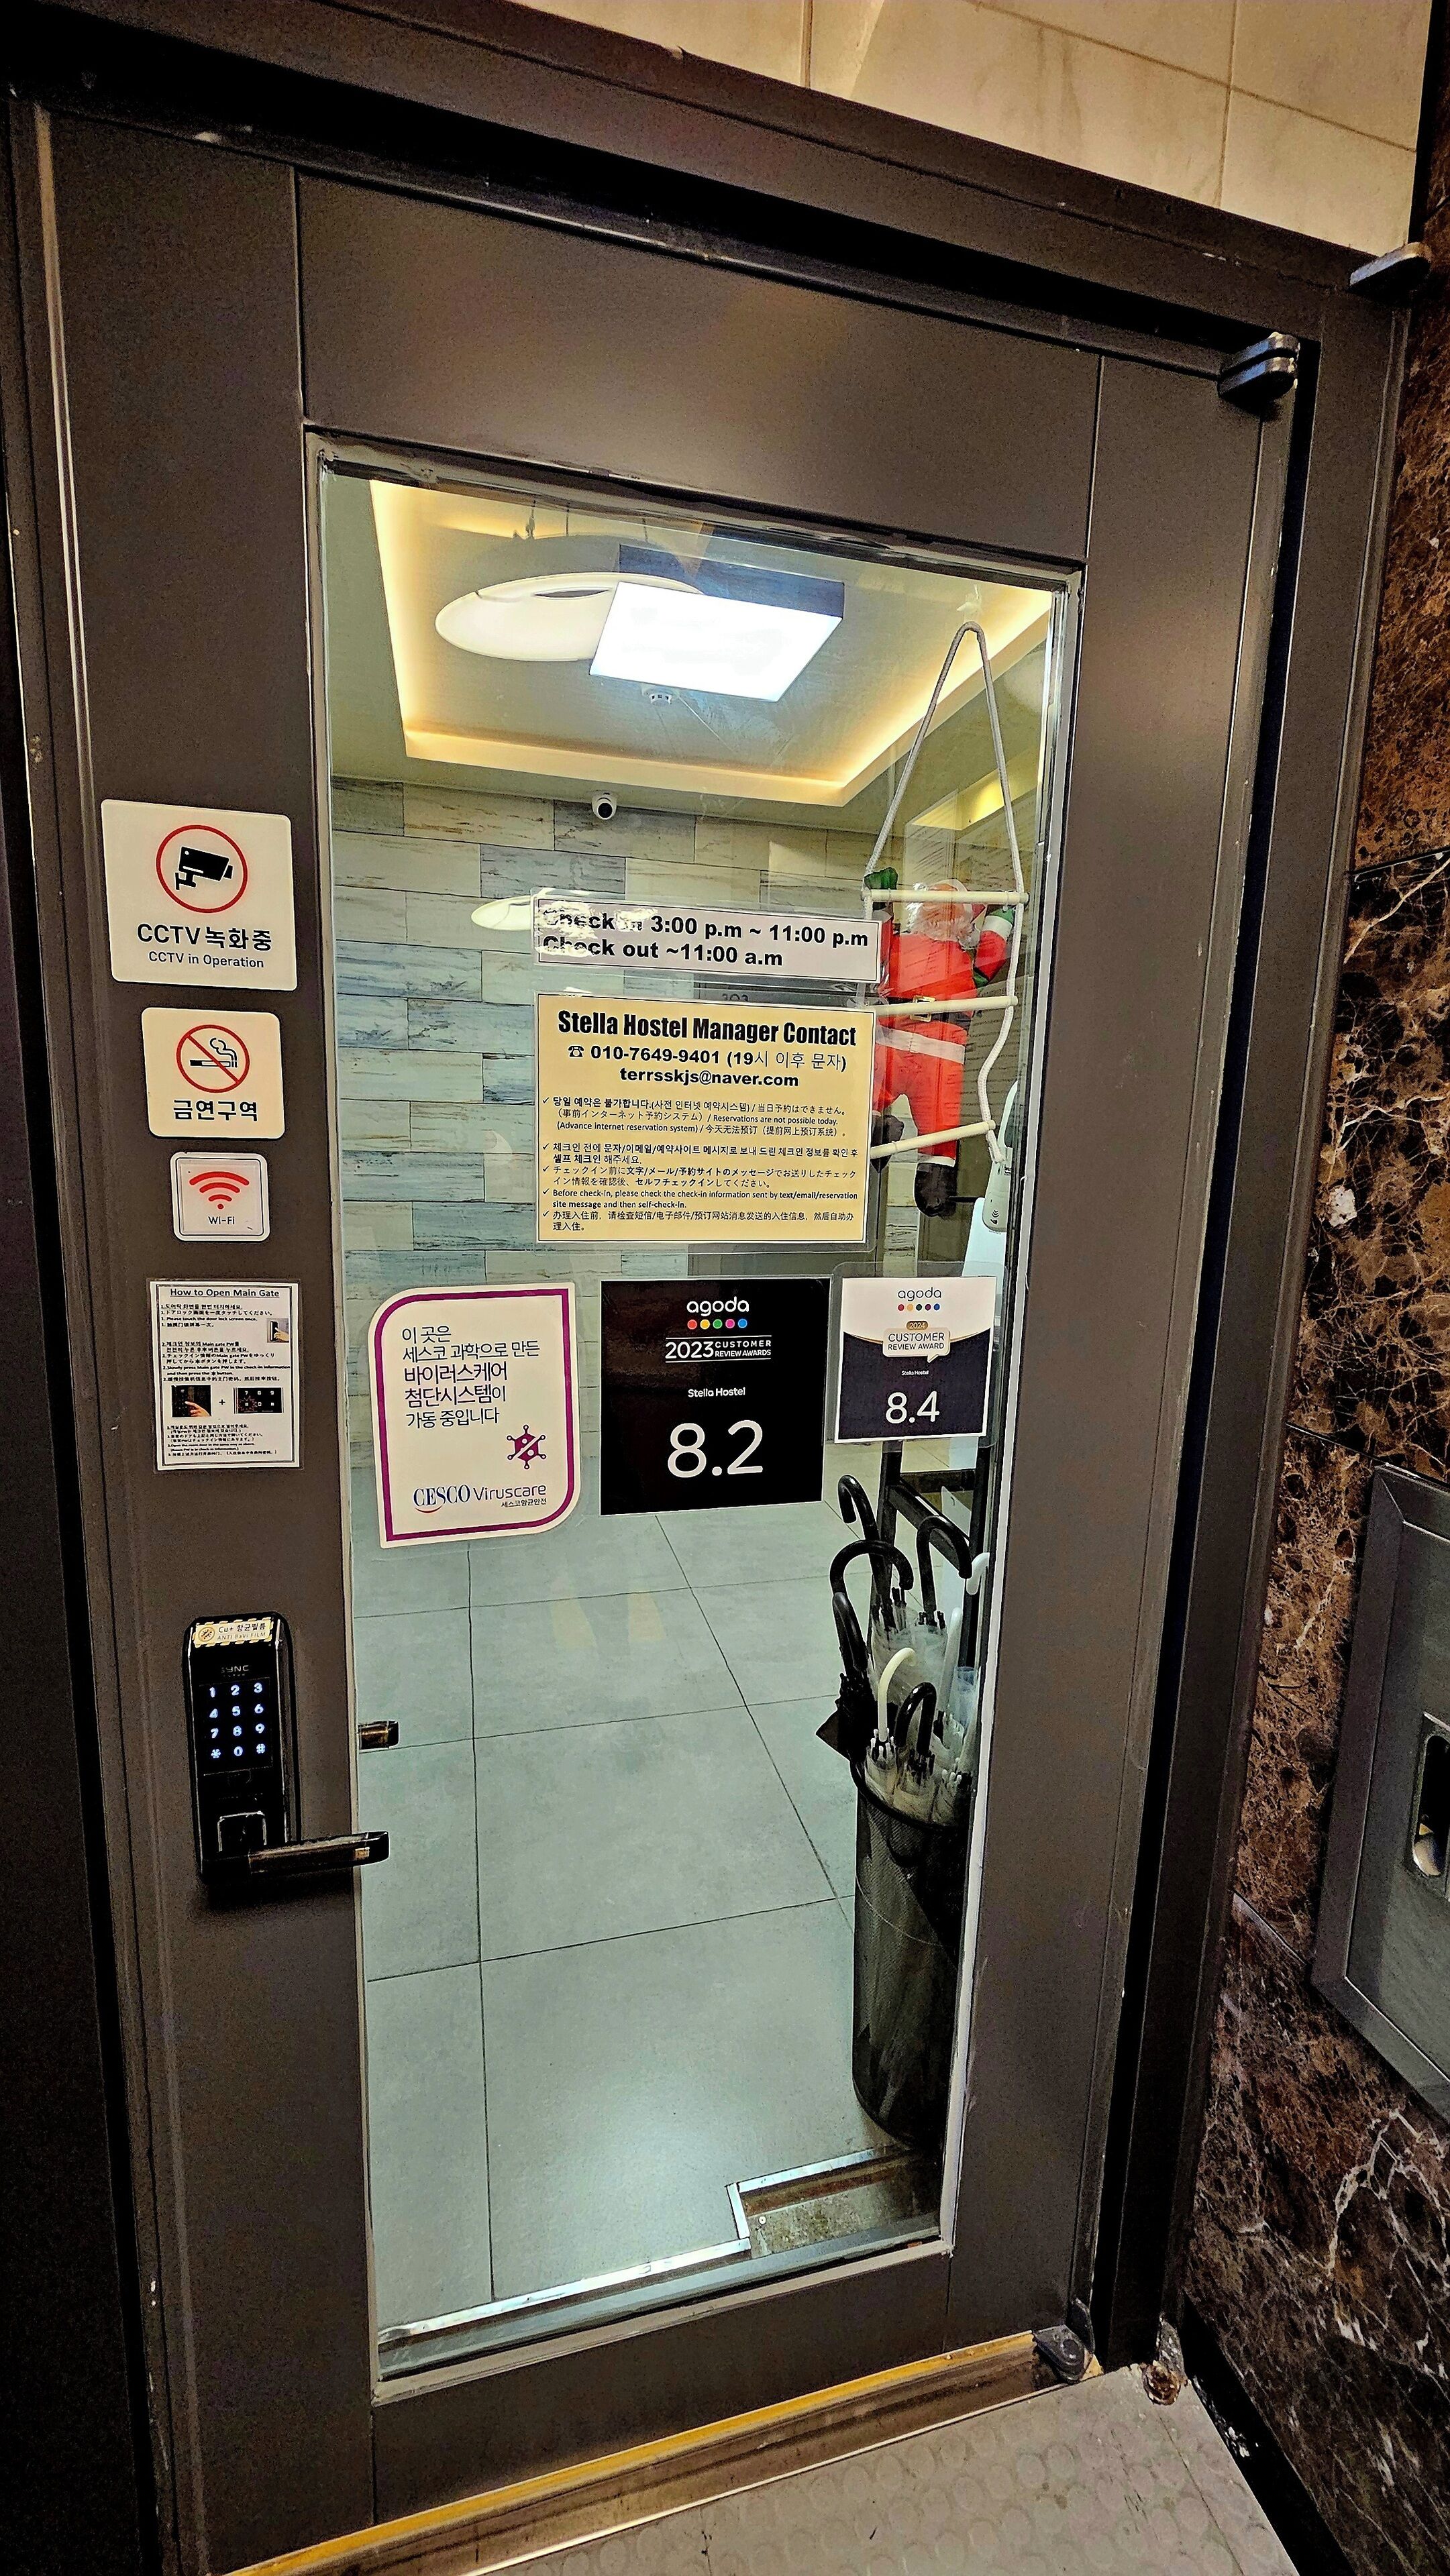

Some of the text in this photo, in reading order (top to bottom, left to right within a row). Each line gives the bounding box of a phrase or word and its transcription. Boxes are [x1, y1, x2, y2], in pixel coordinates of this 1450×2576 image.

[137, 923, 201, 945] CCTV
[651, 915, 697, 934] 3:00
[705, 923, 741, 939] p.m
[770, 924, 825, 943] 11:00
[833, 932, 868, 948] p.m
[149, 951, 264, 968] CCTV in Operation
[623, 942, 659, 958] out
[666, 943, 737, 963] ~11:00
[745, 953, 782, 966] a.m
[558, 1010, 856, 1046] Stella Hostel Manager Contact
[591, 1045, 847, 1072] 010-7649-9401 (19시 이후 문자)
[620, 1067, 798, 1086] terrsskjs@naver.com
[174, 1099, 258, 1122] 금연구역
[553, 1097, 571, 1107] 당일
[574, 1097, 602, 1108] 예약은
[675, 1101, 701, 1111] 인터넷
[557, 1122, 592, 1130] (Advance
[594, 1122, 624, 1130] internet
[627, 1123, 668, 1132] reservation
[670, 1124, 698, 1133] system)
[714, 1115, 758, 1123] Reservations
[788, 1117, 815, 1125] possible
[817, 1118, 838, 1126] today.
[553, 1143, 580, 1152] 체크인
[583, 1144, 601, 1152] 전에
[703, 1146, 737, 1155] 메시지로
[740, 1146, 757, 1155] 보내
[759, 1147, 776, 1156] 드린
[778, 1147, 803, 1157] 체크인
[850, 1148, 858, 1157] 후
[553, 1154, 641, 1164] 셀프 체크인 해주세요.
[615, 1190, 638, 1198] please
[770, 1191, 778, 1200] by
[568, 1201, 601, 1210] message
[208, 1216, 236, 1225] Wi-Fi
[898, 1287, 942, 1301] agoda
[686, 1296, 749, 1317] agoda
[402, 1326, 452, 1344] 이 곳은
[888, 1332, 945, 1342] CUSTOMER
[403, 1341, 540, 1362] 세스코 과학으로 만든
[665, 1340, 772, 1359] 2023 CUSTOMER
[404, 1362, 507, 1386] 바이러스케어
[405, 1385, 506, 1408] 첨단시스템이
[688, 1387, 745, 1398] Stella Hostel
[885, 1391, 939, 1424] 8.4
[406, 1407, 500, 1429] 가동 중입니다
[668, 1419, 763, 1478] 8.2
[413, 1483, 547, 1507] CESCO Viruscare
[209, 1682, 263, 1697] 1 2 3
[209, 1704, 264, 1719] 4 5 6
[211, 1723, 264, 1739] 7 8 9
[234, 1746, 243, 1757] 0
